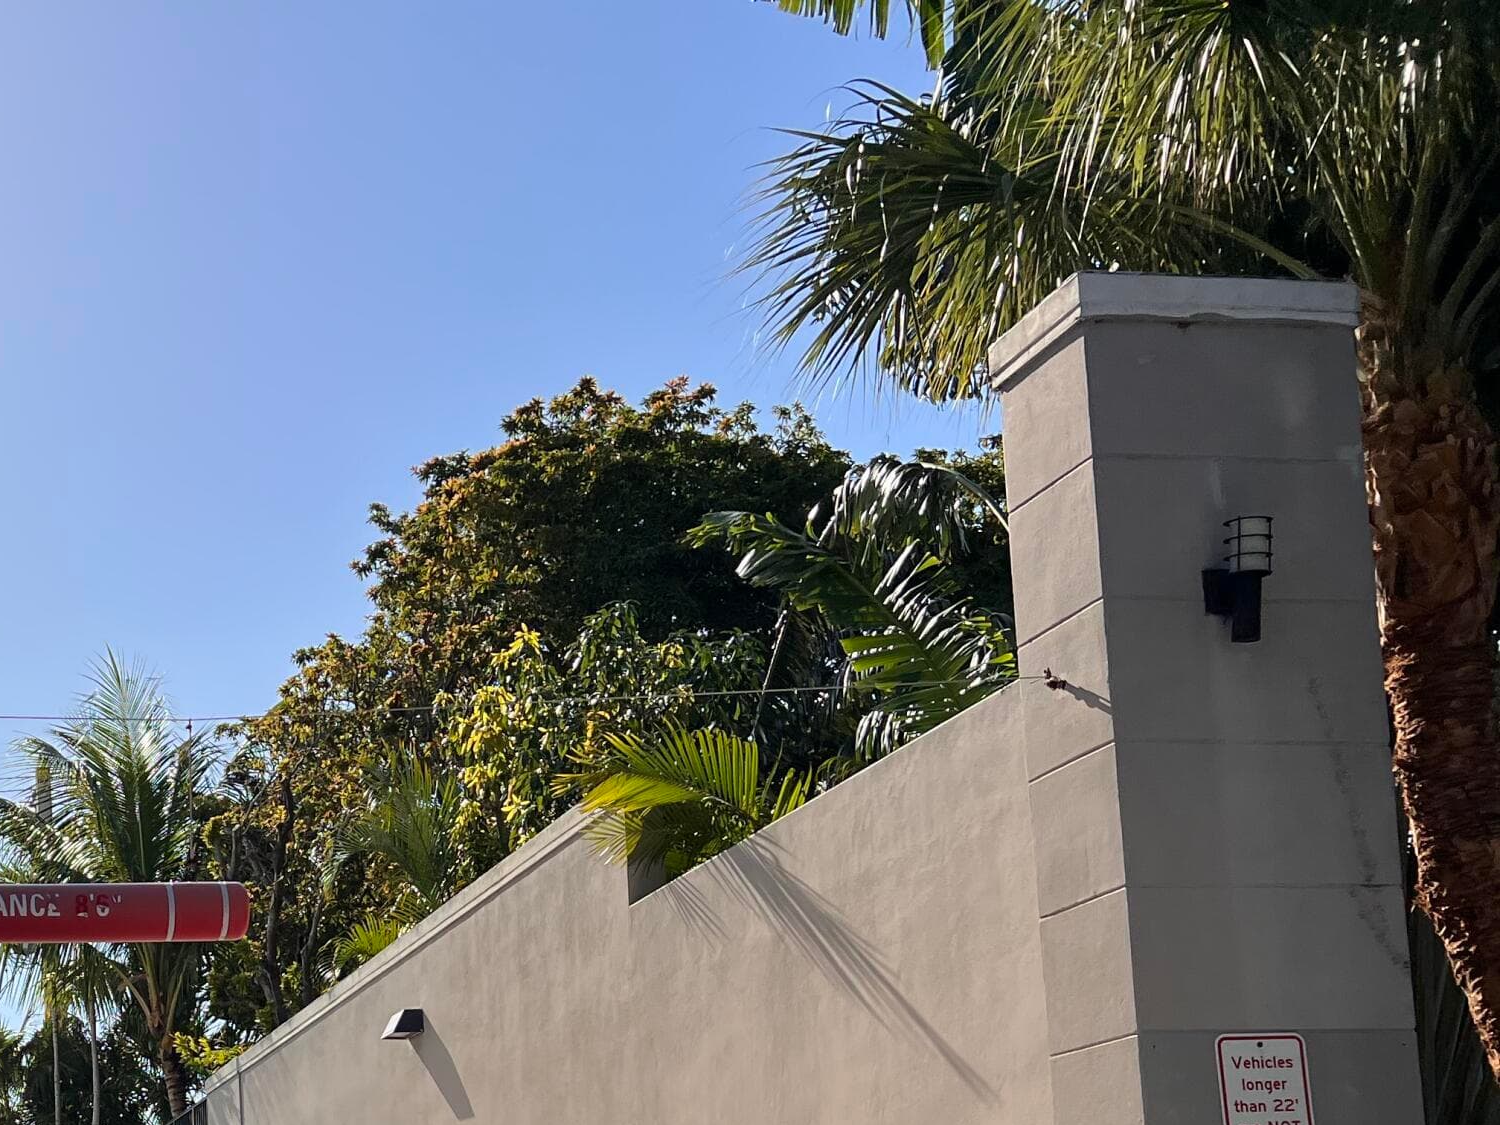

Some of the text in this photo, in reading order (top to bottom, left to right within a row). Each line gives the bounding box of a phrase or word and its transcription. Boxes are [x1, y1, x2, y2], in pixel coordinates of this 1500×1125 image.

[1231, 1056, 1293, 1069] Vehicles
[1241, 1078, 1287, 1094] longer
[1234, 1099, 1299, 1113] than 22'
